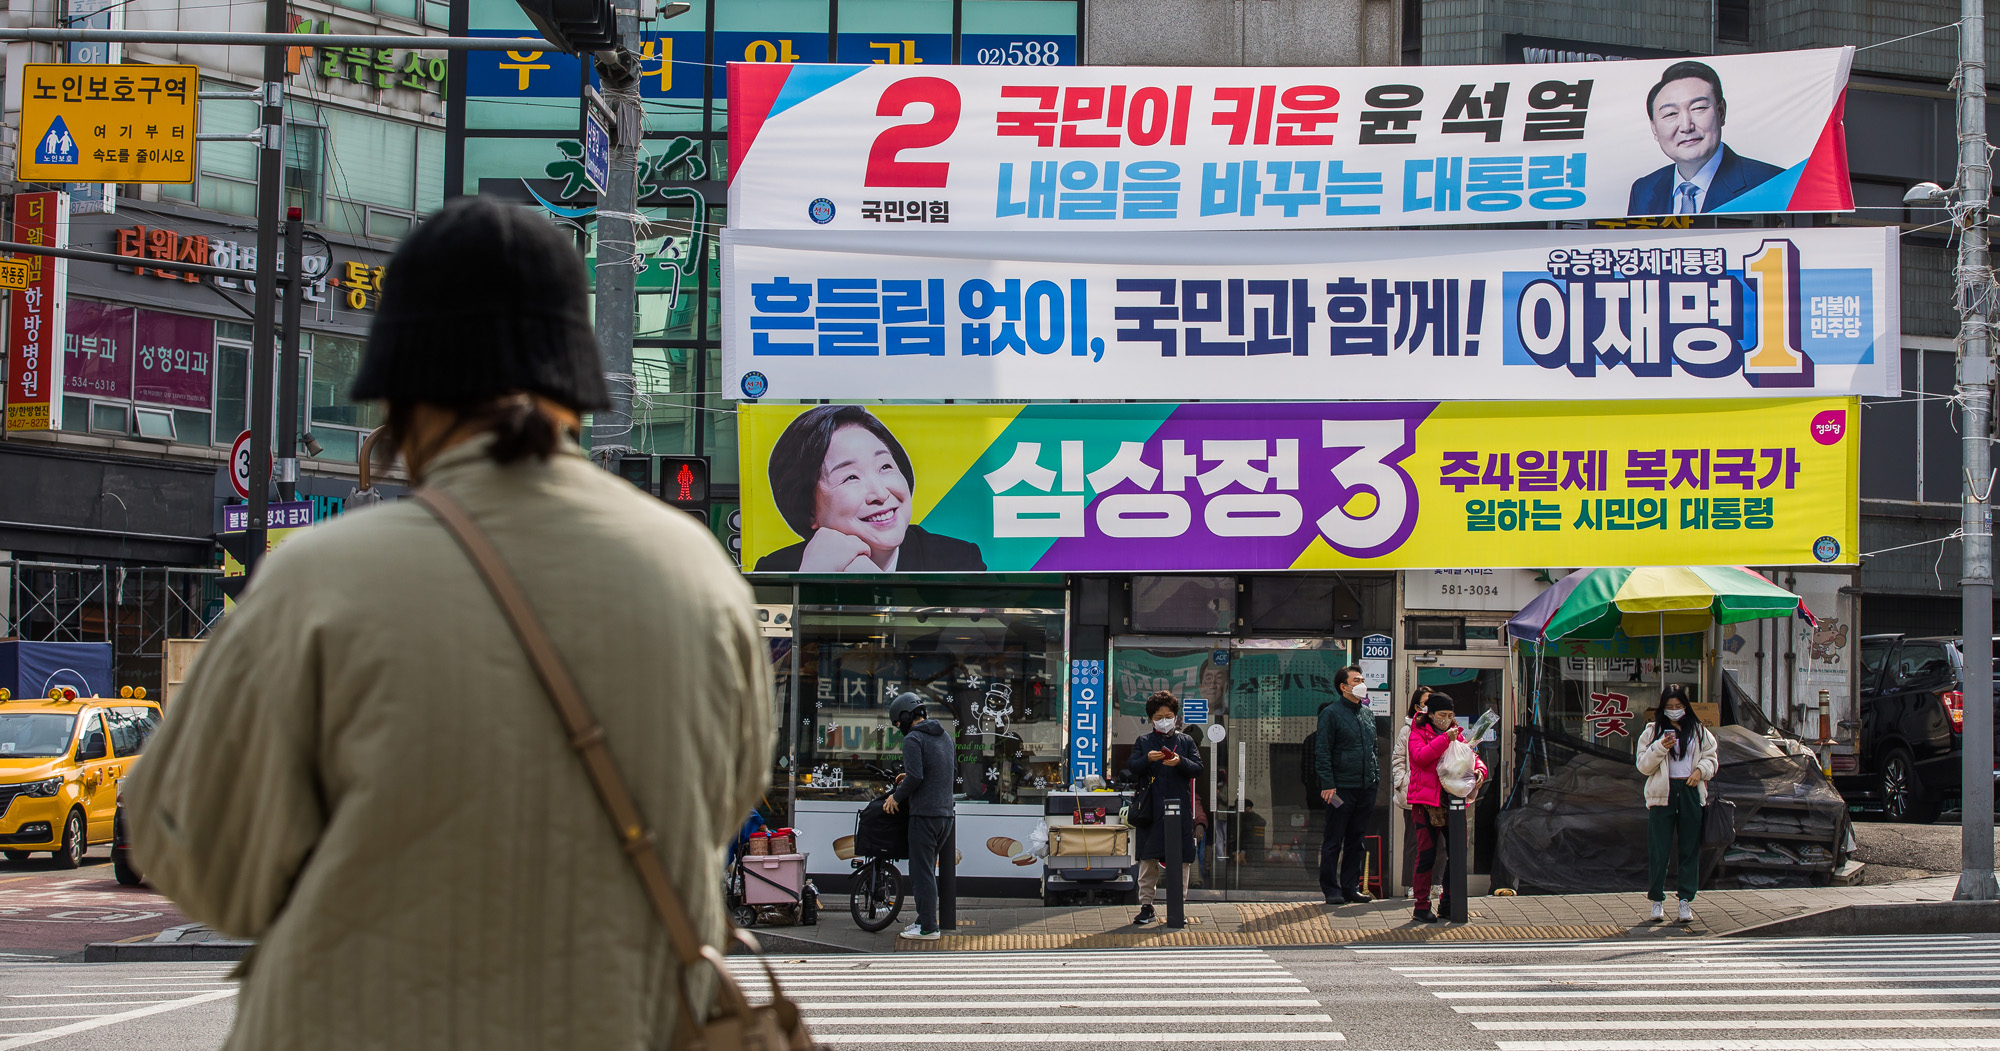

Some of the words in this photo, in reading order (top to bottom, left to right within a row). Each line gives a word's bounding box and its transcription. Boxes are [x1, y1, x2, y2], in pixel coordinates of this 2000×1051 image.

[33, 75, 187, 105] 노인보호구역
[996, 85, 1192, 148] 국민이
[1211, 85, 1340, 147] 키운
[864, 77, 961, 188] 2
[93, 148, 130, 163] 속도를
[136, 149, 185, 163] 줄이시오
[995, 160, 1181, 220] 내일을
[1199, 159, 1384, 218] 바꾸는
[1402, 152, 1587, 213] 대통령
[814, 206, 830, 216] 선거
[861, 200, 949, 223] 국민의힘
[1, 265, 25, 285] 작동중
[1548, 250, 1614, 276] 유능한
[1618, 249, 1724, 276] 경제대통령
[750, 277, 946, 357] 흔들림
[958, 278, 1105, 363] 없이,
[1114, 278, 1316, 357] 국민과
[1326, 277, 1487, 357] 함께!
[1745, 240, 1804, 374] 1
[1810, 295, 1861, 317] 더불어
[1519, 278, 1733, 366] 이재명
[1810, 317, 1862, 339] 민주당
[21, 286, 43, 397] 한방병원
[65, 333, 118, 363] 피부과
[139, 345, 209, 376] 성형외과
[72, 376, 116, 391] 534-6318
[747, 380, 763, 390] 선거
[7, 419, 49, 428] 3427-8275
[1816, 422, 1841, 435] 정의당
[1316, 419, 1407, 549] 3
[1440, 450, 1608, 493] 주4일제
[1624, 447, 1801, 491] 복지국가
[983, 438, 1304, 538] 심상정
[289, 508, 309, 525] 금지
[1465, 499, 1562, 532] 일하는
[1574, 498, 1667, 531] 시민의
[1680, 497, 1774, 530] 대통령
[1818, 545, 1834, 554] 선거
[1441, 584, 1499, 596] 581-3034
[1366, 646, 1389, 656] 2060
[1585, 692, 1634, 737] 꽃
[1076, 688, 1098, 780] 우리안과
[957, 753, 978, 763] Cake
